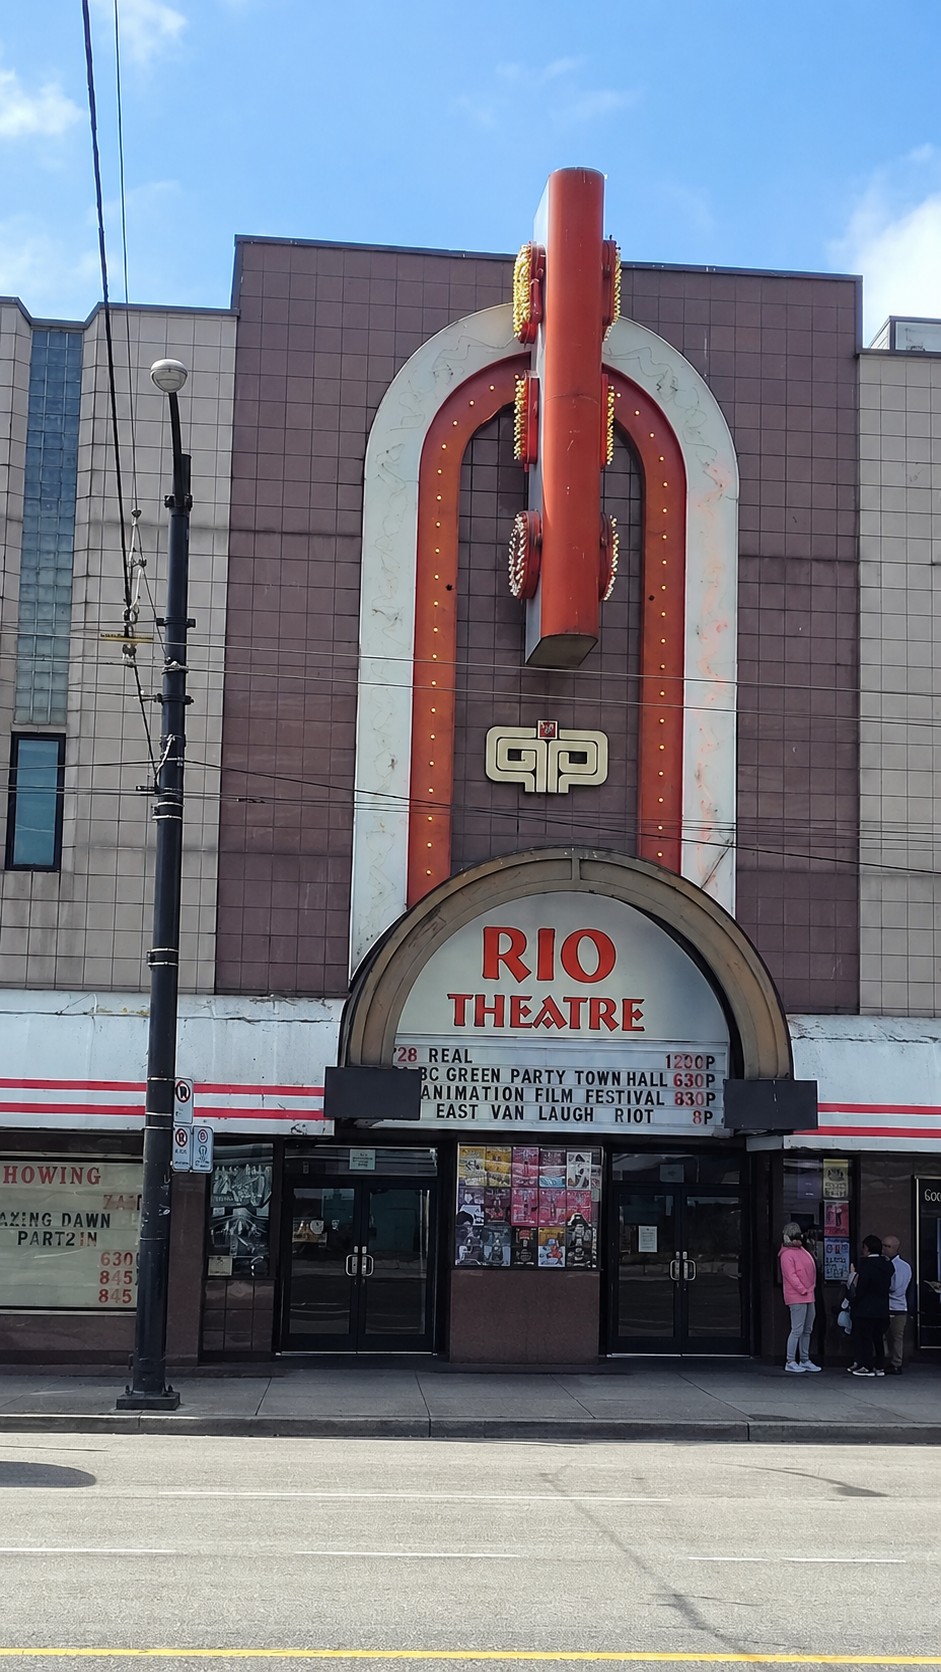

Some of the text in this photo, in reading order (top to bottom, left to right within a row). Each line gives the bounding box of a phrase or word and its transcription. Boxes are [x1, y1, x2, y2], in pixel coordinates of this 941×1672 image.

[481, 926, 617, 984] RIO
[447, 993, 646, 1032] THEATRE
[428, 1048, 473, 1064] REAL
[665, 1054, 716, 1070] 1200P
[446, 1067, 501, 1083] GREEN
[510, 1069, 566, 1085] PARTY
[575, 1071, 621, 1086] TOWN
[627, 1072, 668, 1087] HALL
[673, 1073, 716, 1088] 630P
[420, 1084, 716, 1107] ANIMATION FILM FESTIVAL 830P
[436, 1103, 714, 1125] EAST VAN LAUGH RIOT 8P
[2, 1165, 102, 1185] HOWING
[61, 1212, 111, 1228] DAWN
[100, 1251, 139, 1267] 630
[99, 1268, 139, 1285] 845
[98, 1288, 132, 1304] 845
